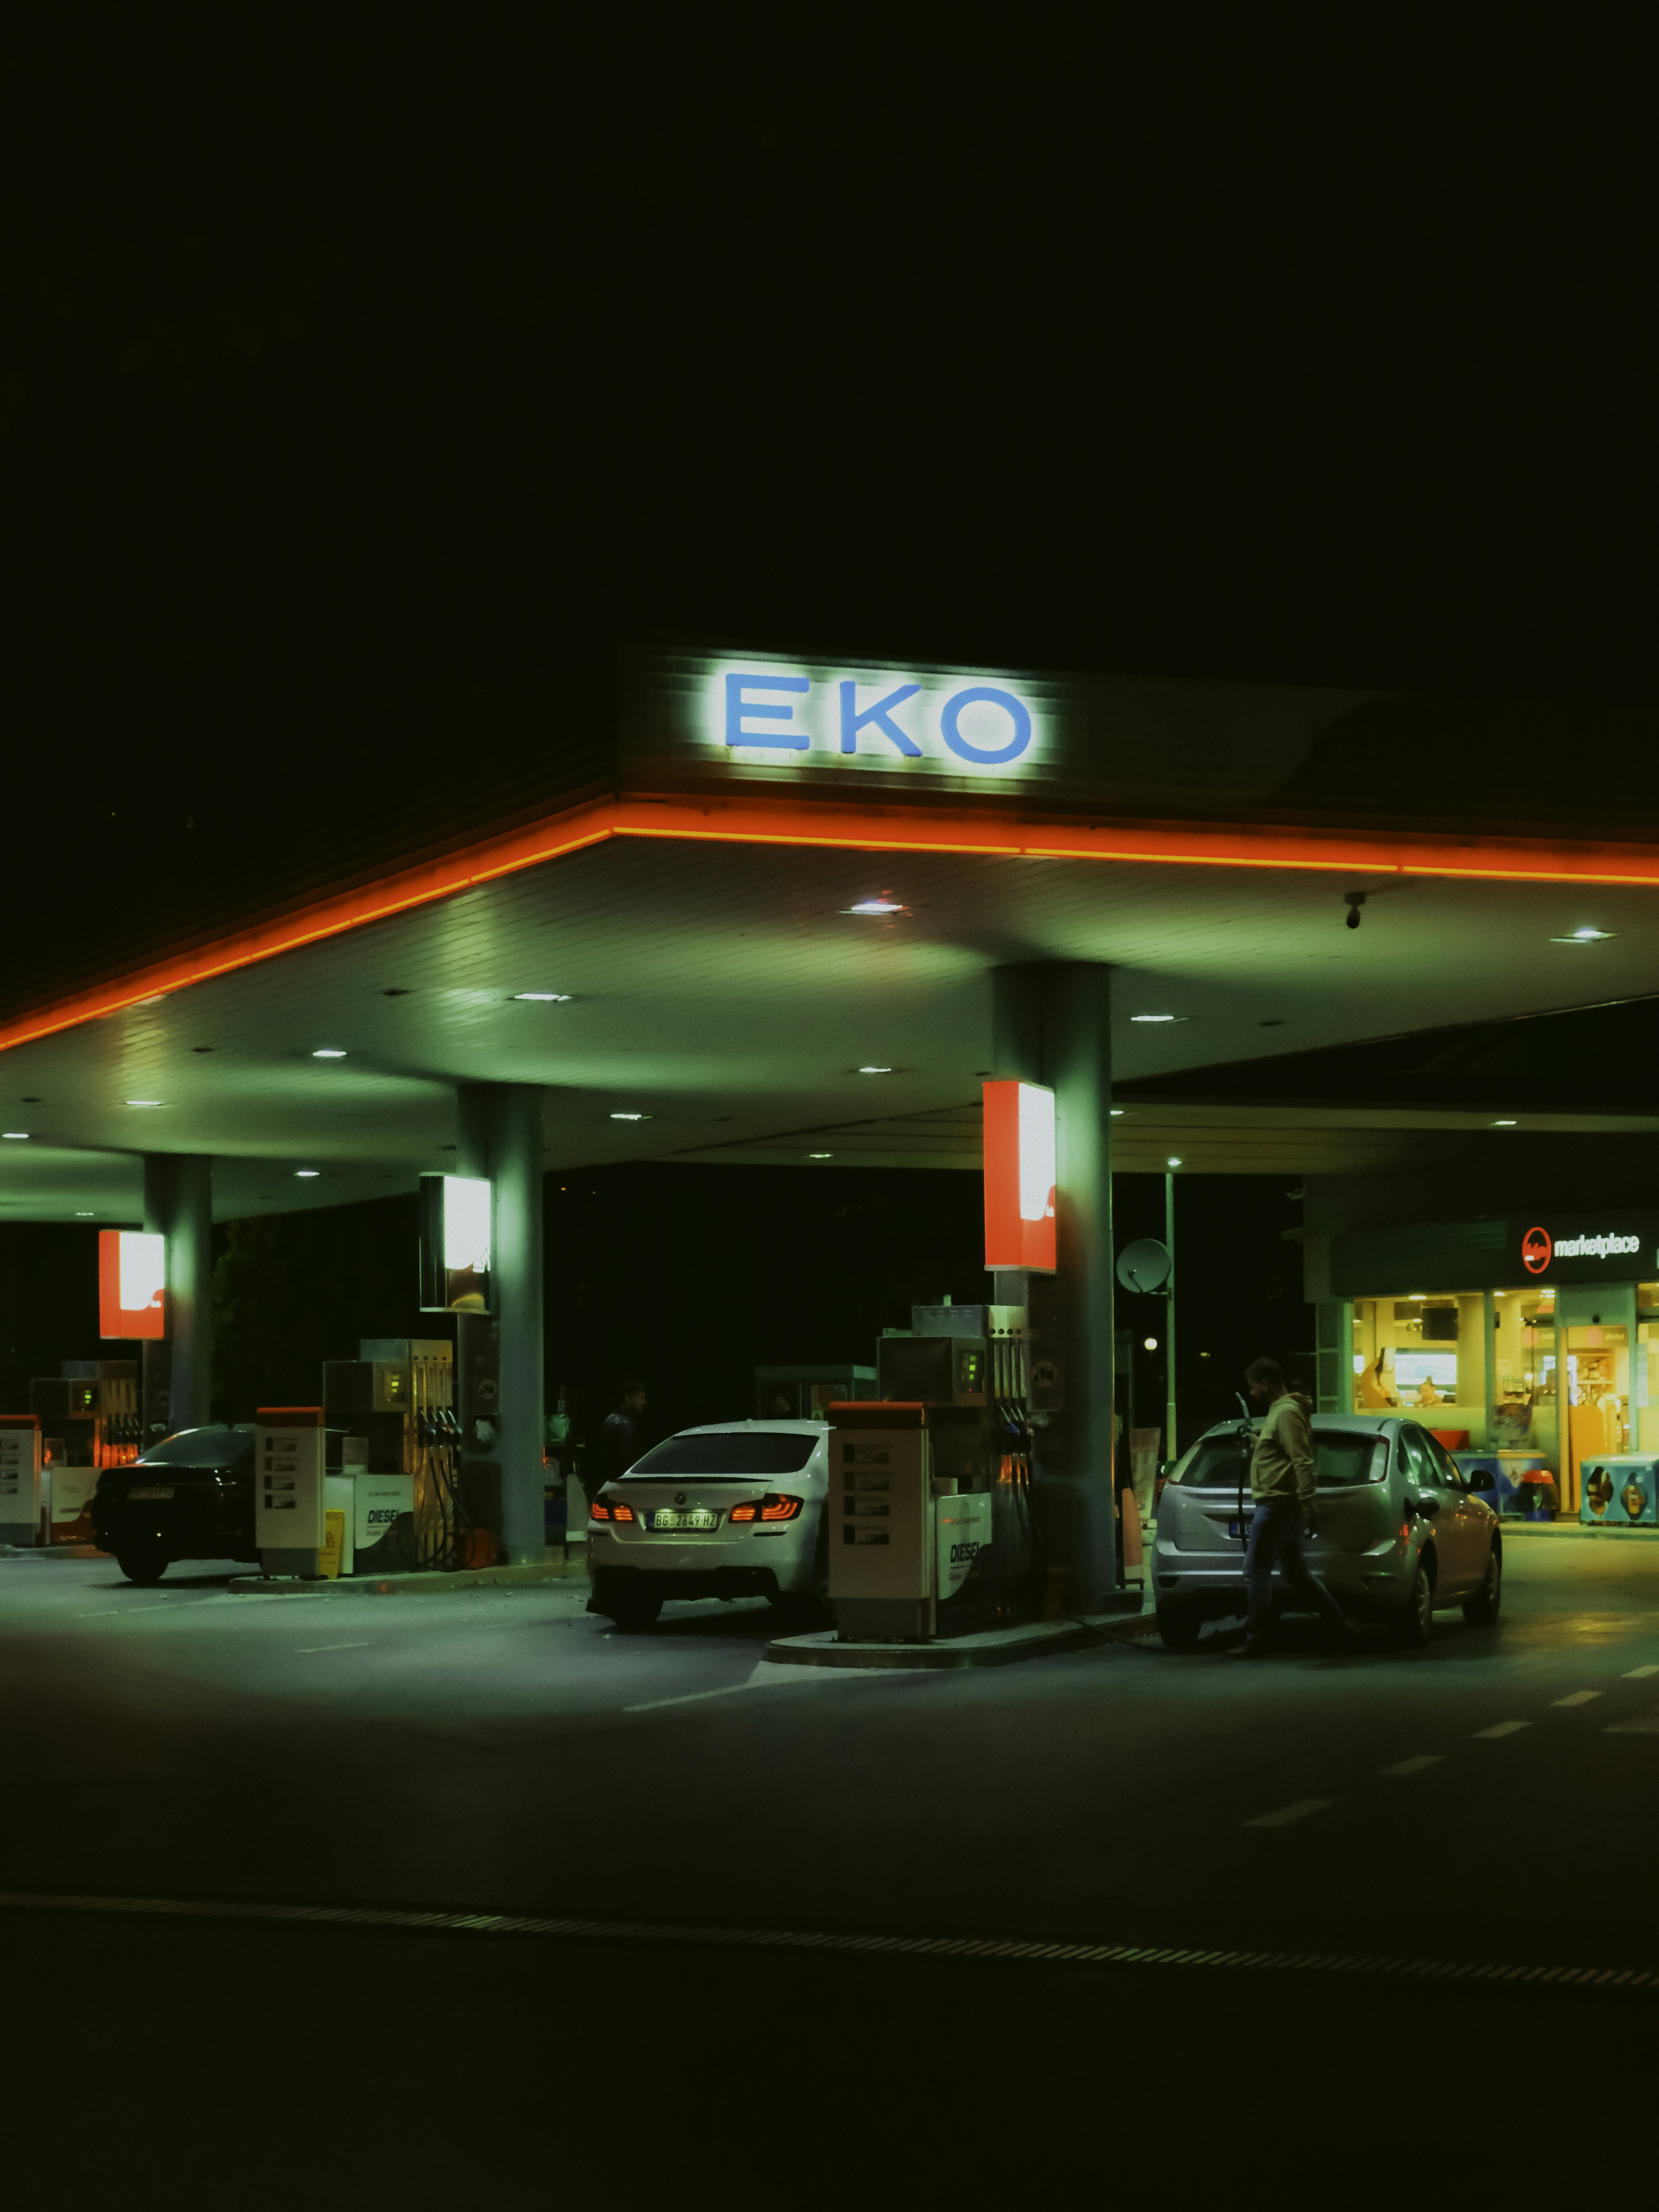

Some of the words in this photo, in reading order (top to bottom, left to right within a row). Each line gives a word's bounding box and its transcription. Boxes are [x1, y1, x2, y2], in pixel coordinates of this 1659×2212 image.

[725, 673, 1032, 764] EKO
[1555, 1232, 1640, 1259] marketplace
[656, 1515, 668, 1526] BG
